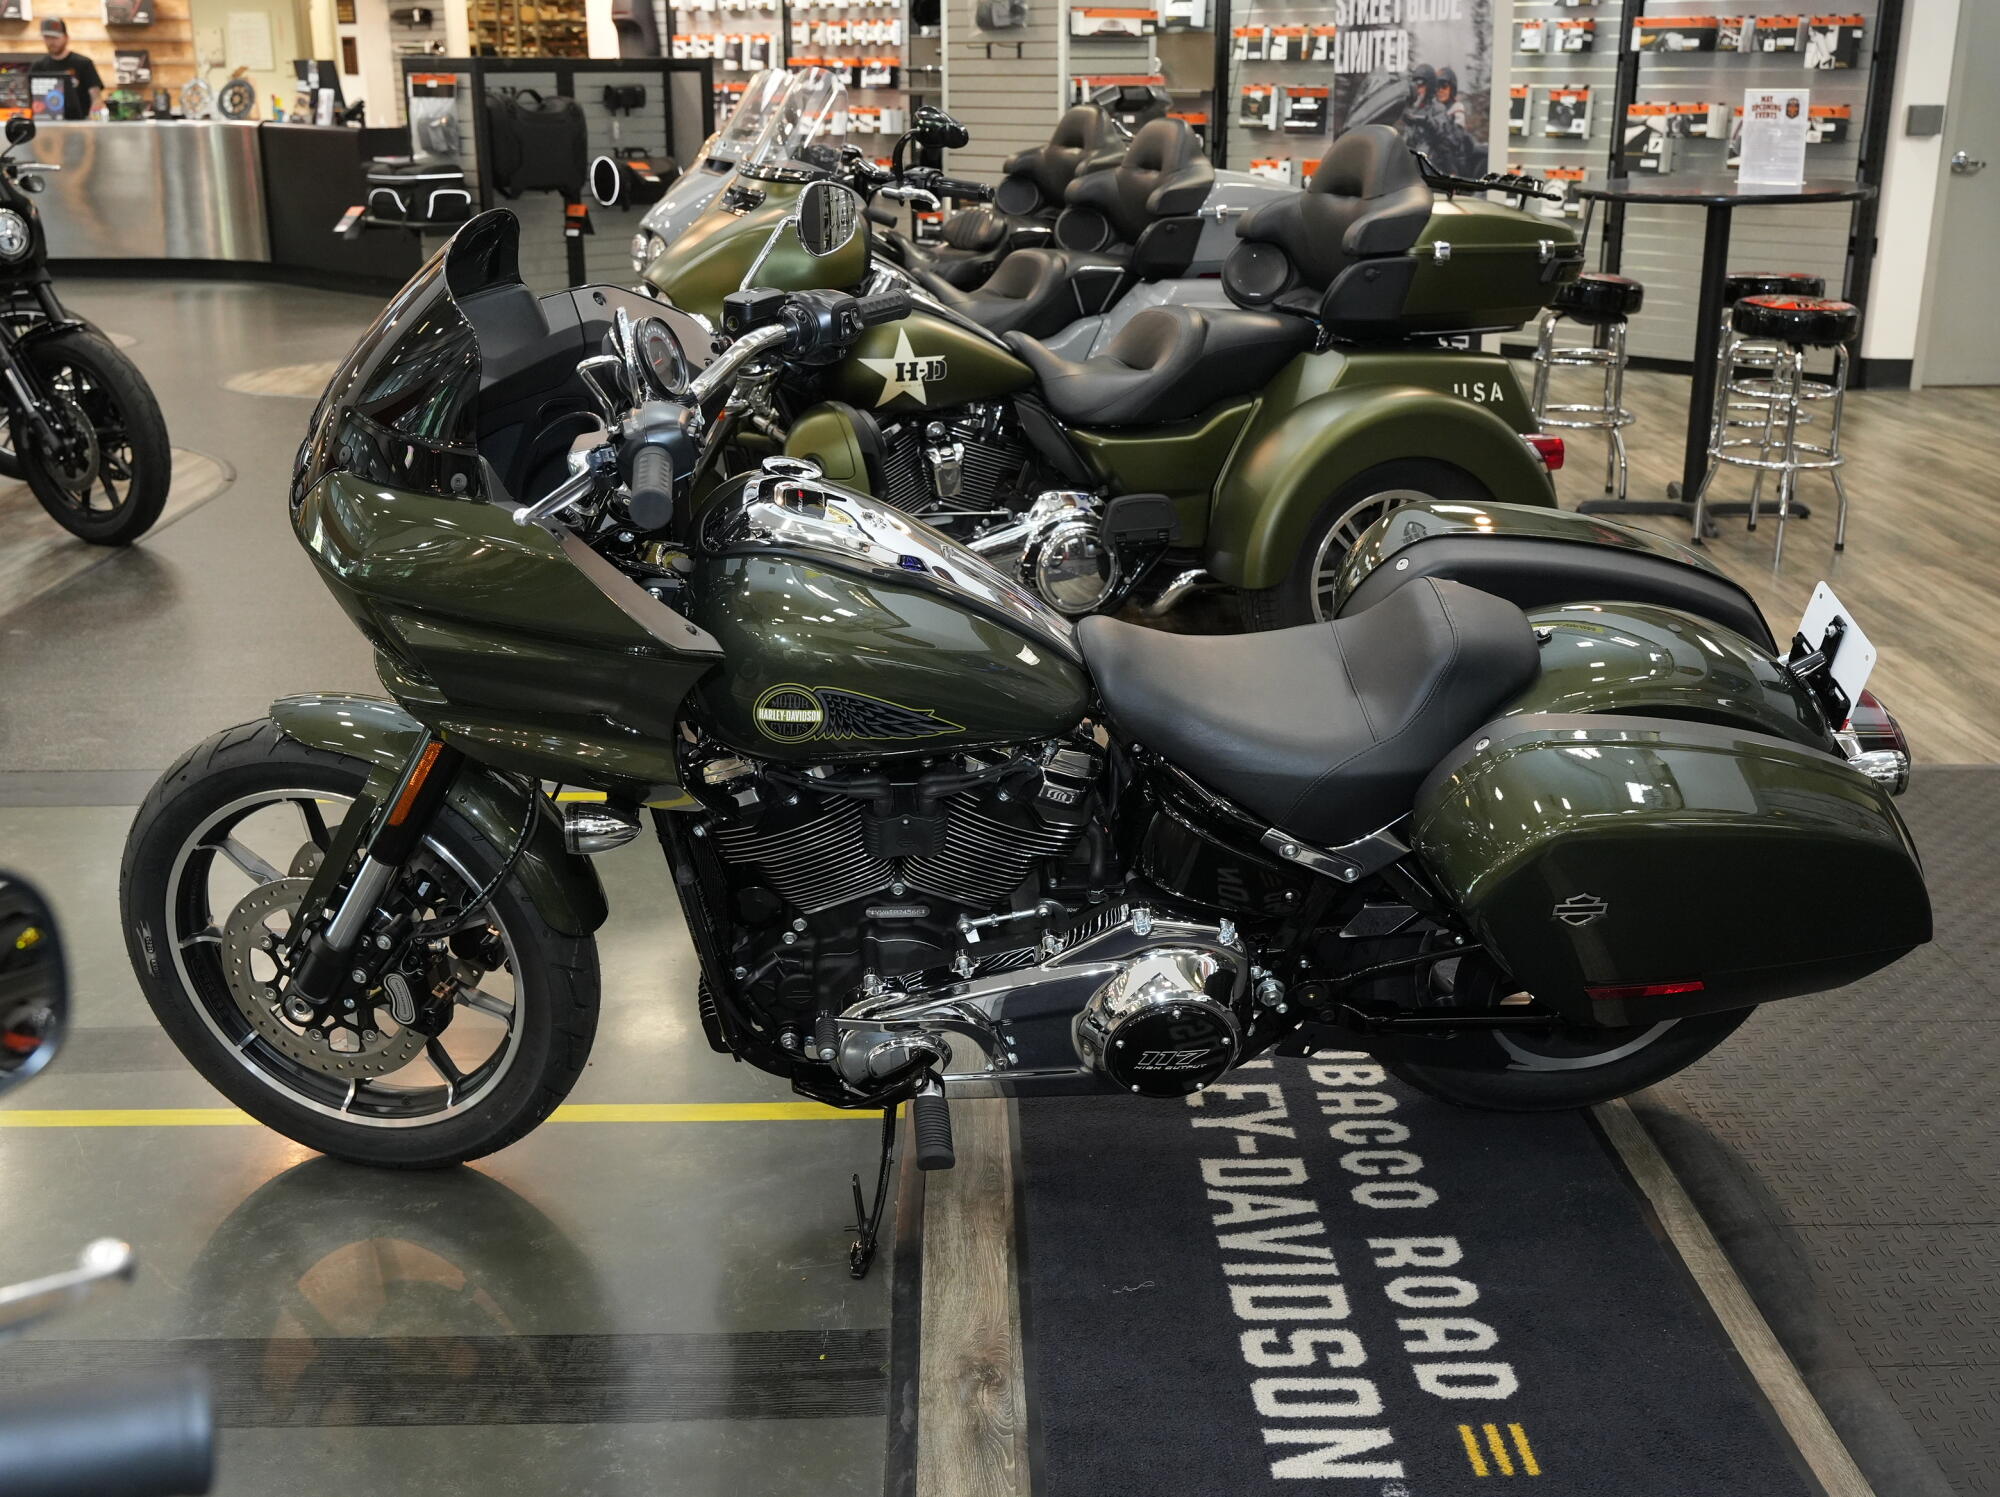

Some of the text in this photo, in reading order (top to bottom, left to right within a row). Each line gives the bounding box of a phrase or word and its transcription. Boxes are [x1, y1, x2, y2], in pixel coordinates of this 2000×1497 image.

[1335, 30, 1408, 74] LIMITED
[895, 359, 948, 382] H-D
[1453, 382, 1504, 403] USA
[771, 695, 808, 708] MOTOR
[759, 708, 821, 722] HARLEY-DAVIDSON
[770, 723, 808, 736] CYCLES
[1137, 1048, 1211, 1066] 117
[1164, 1063, 1208, 1071] OUTPUT
[1366, 1234, 1519, 1400] ROAD
